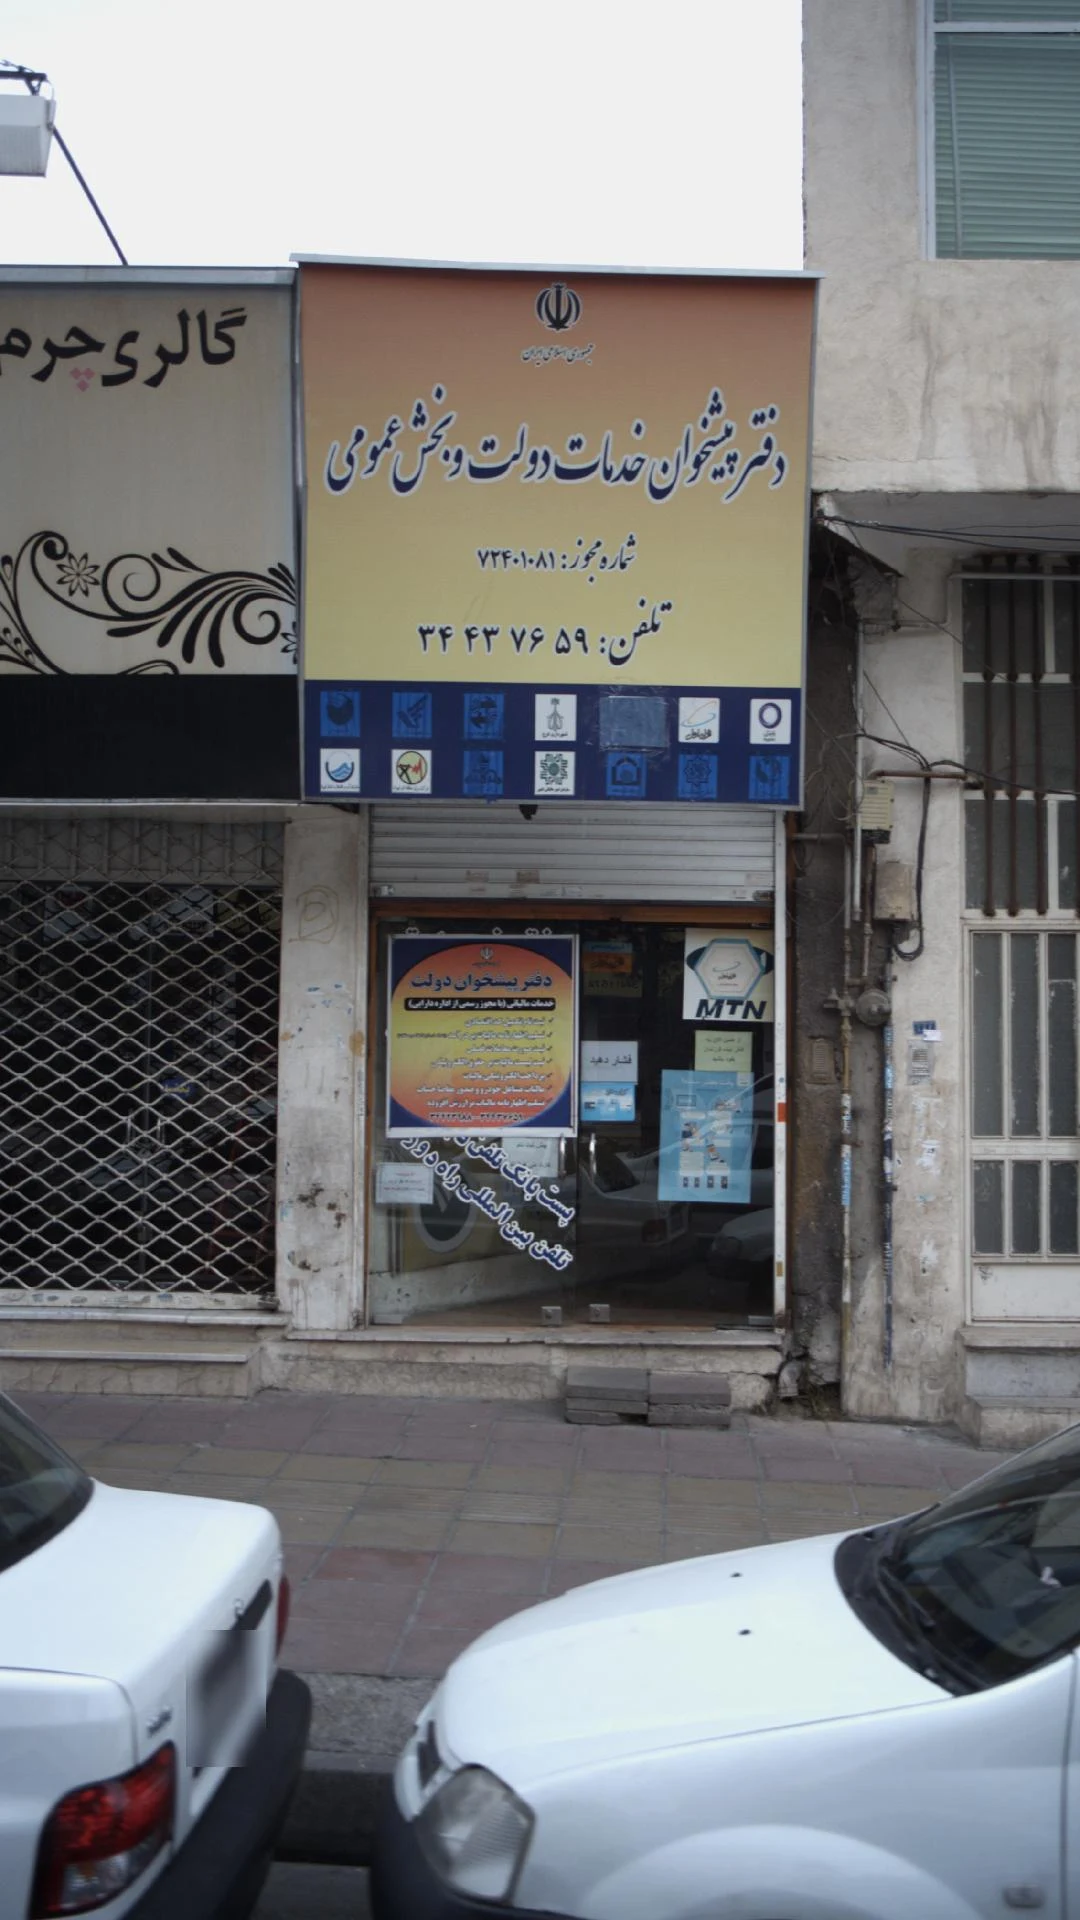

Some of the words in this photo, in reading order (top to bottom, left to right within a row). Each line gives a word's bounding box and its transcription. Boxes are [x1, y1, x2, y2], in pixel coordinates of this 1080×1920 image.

[101, 307, 247, 388] گالری
[326, 417, 402, 493] عمومی
[392, 385, 454, 495] بخش
[467, 425, 552, 481] دولت
[553, 421, 647, 483] خدمات
[649, 389, 739, 501] پیشخوان
[725, 405, 786, 501] دفتر
[448, 447, 464, 479] و
[599, 534, 636, 571] شماره
[417, 625, 453, 653] ۳۴
[464, 625, 500, 653] ۴۳
[510, 626, 544, 653] ۷۶
[555, 627, 588, 654] ۵۹
[599, 598, 673, 667] تلفن:
[410, 973, 452, 992] دولت
[453, 972, 518, 993] پیشخوان
[520, 972, 552, 992] دفتر
[695, 998, 767, 1020] MTN
[589, 1054, 609, 1065] دهید
[611, 1053, 633, 1067] فشار
[465, 1142, 509, 1169] تلفن
[435, 1160, 462, 1191] راه
[501, 1161, 541, 1201] بانک
[456, 1184, 515, 1225] المللی
[537, 1184, 576, 1228] پست
[501, 1221, 534, 1250] بین
[529, 1239, 574, 1270] تلفن
